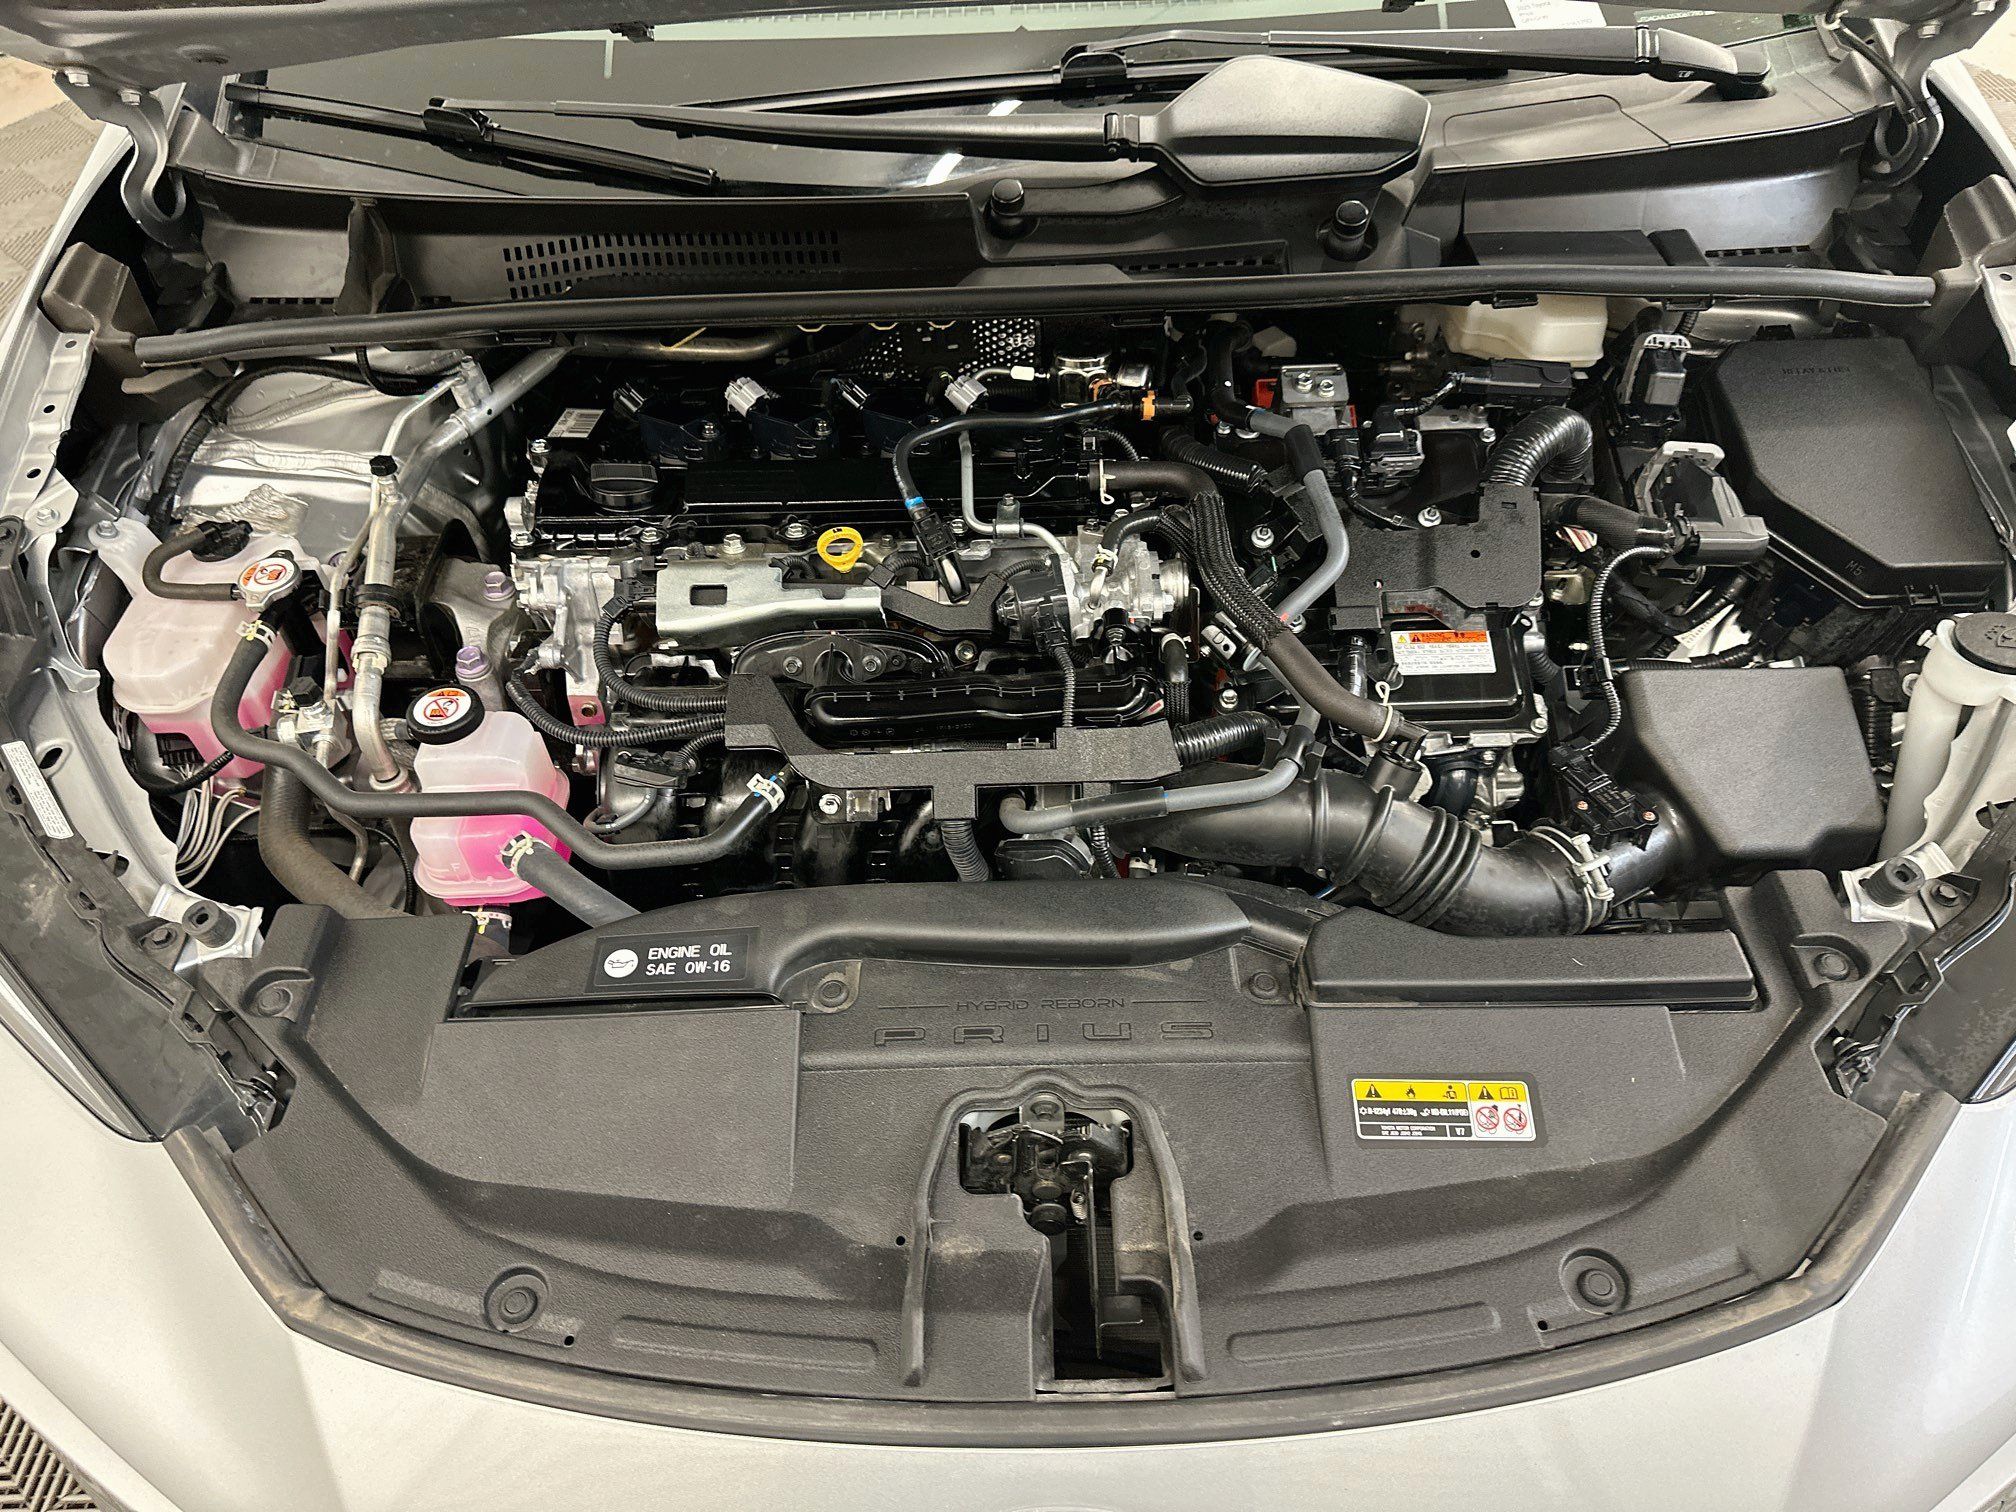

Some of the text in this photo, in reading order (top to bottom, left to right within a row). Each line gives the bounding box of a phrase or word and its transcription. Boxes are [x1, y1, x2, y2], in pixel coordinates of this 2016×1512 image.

[648, 943, 732, 960] ENGINE OIL
[645, 960, 731, 976] SAE 0W-16
[955, 998, 1125, 1011] HYBRID REBORN
[874, 1021, 1213, 1046] PRIUS
